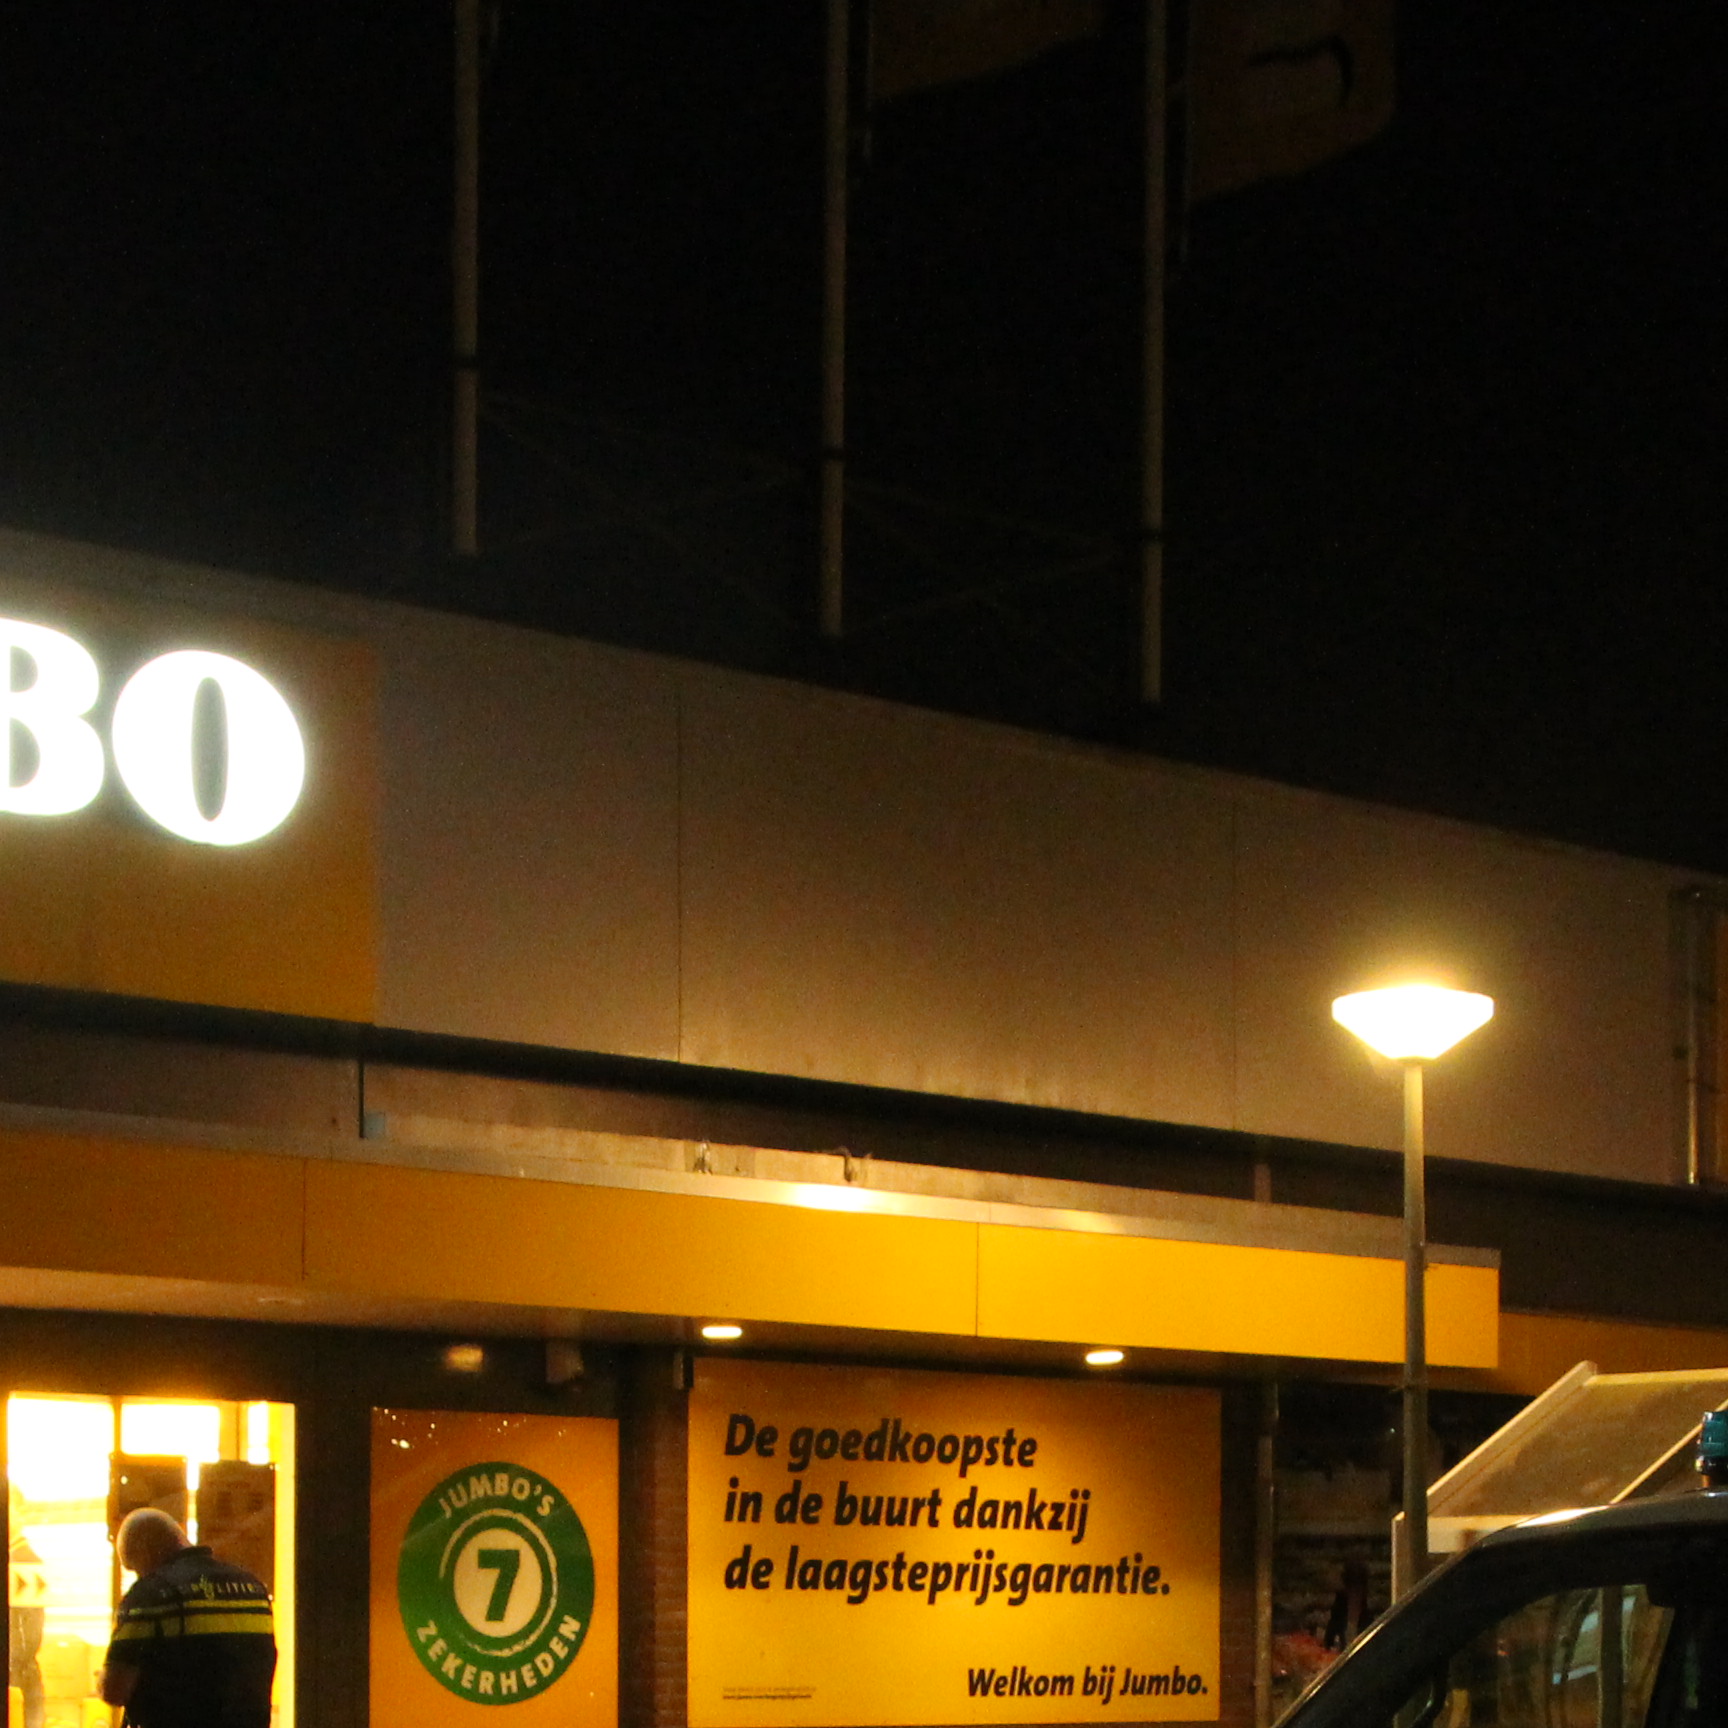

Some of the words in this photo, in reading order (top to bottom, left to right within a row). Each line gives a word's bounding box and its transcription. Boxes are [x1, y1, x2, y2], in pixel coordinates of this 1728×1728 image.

[725, 1413, 779, 1459] De
[787, 1418, 1038, 1478] goedkoopste
[439, 1472, 555, 1519] JUMBO'S
[725, 1477, 763, 1523] in
[774, 1479, 823, 1525] de
[834, 1481, 942, 1528] buurt
[953, 1486, 1091, 1545] dankzij
[477, 1548, 521, 1622] 7
[724, 1544, 774, 1591] de
[785, 1545, 1171, 1607] laagsteprijsgarantie.
[415, 1614, 582, 1697] ZEKERHEDEN
[968, 1666, 1075, 1698] Welkom
[1082, 1666, 1115, 1705] bij
[1119, 1667, 1209, 1698] Jumbo.
